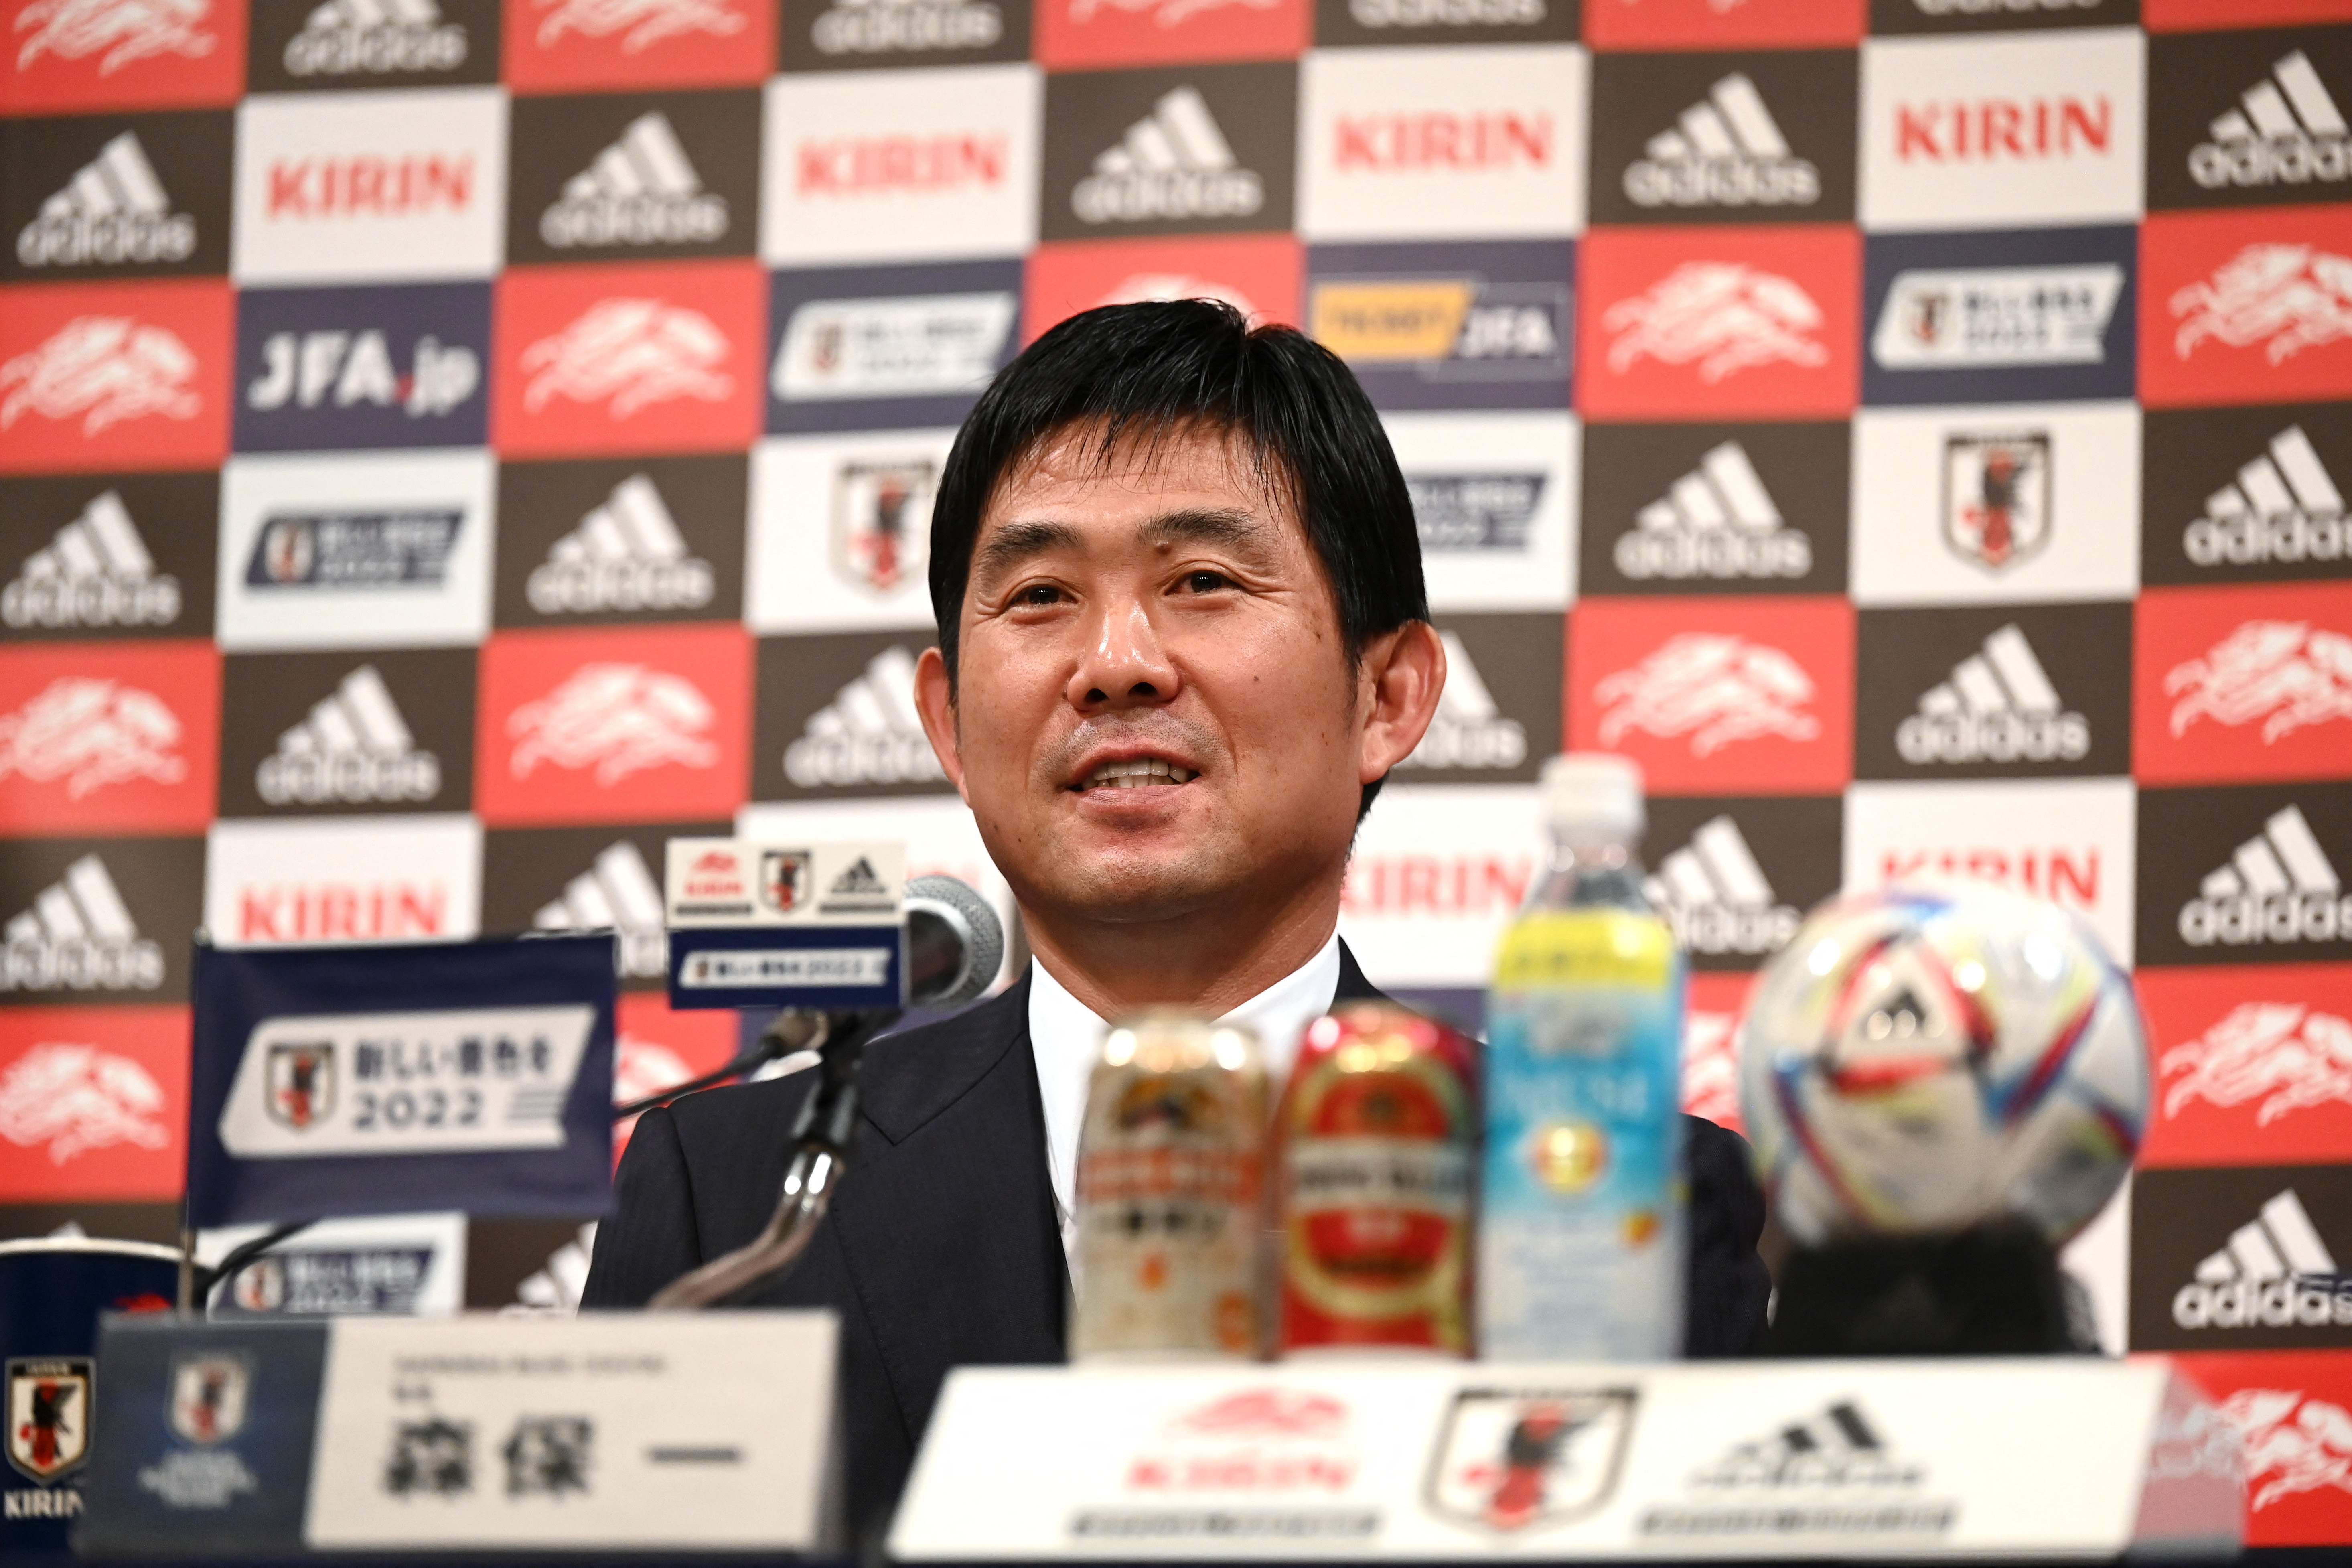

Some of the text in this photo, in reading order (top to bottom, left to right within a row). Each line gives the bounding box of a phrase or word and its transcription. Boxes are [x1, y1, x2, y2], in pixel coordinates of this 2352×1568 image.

[1336, 112, 1549, 170] KIRIN
[1894, 97, 2111, 161] KIRIN
[266, 156, 472, 219] KIRIN
[797, 134, 1008, 195] KIRIN
[1622, 159, 1821, 207] adidas
[2187, 140, 2352, 189] adida
[540, 194, 729, 247] adidas
[1071, 168, 1264, 223] adidas
[17, 213, 197, 266] adidas
[249, 330, 480, 416] JFA.jp
[1614, 527, 1814, 580] adidas
[527, 558, 716, 615] adidas
[1895, 710, 2090, 765] adidas
[256, 751, 441, 804] adidas
[239, 887, 445, 941] KIRIN
[353, 1089, 484, 1130] 2022
